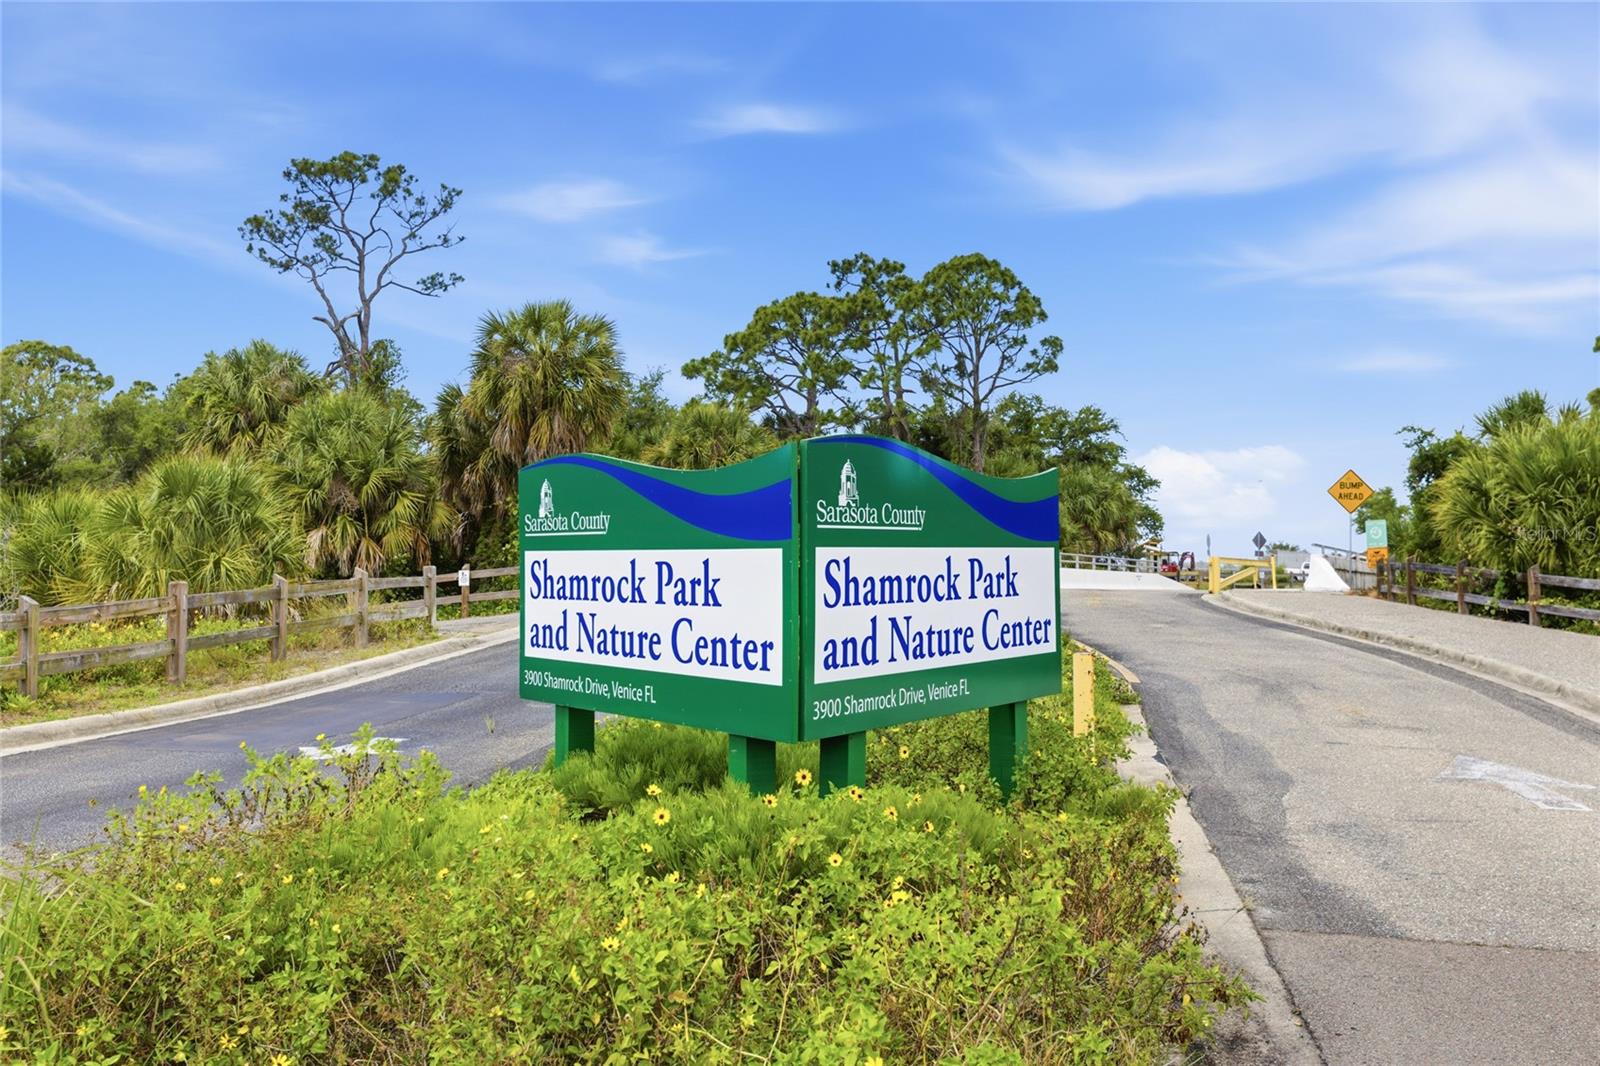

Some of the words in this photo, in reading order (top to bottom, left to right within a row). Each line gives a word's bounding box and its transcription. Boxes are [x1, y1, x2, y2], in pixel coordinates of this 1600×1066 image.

[816, 499, 879, 524] Sarasota
[881, 502, 926, 530] County
[1338, 492, 1364, 500] AHEAD
[524, 513, 568, 532] Sarasota
[571, 511, 611, 534] County
[529, 558, 647, 604] Shamrock
[655, 558, 722, 607] Park
[823, 555, 962, 609] Shamrock
[968, 555, 1019, 599] Park
[530, 609, 569, 651] and
[576, 612, 662, 660] Nature
[671, 617, 774, 672] Center
[823, 615, 879, 671] and
[888, 616, 975, 663] Nature
[981, 608, 1051, 651] Center
[524, 670, 543, 686] 3900
[544, 672, 583, 693] Shamrock
[585, 677, 610, 699] Drive,
[611, 681, 643, 702] Venice
[644, 685, 656, 704] FL
[812, 698, 842, 720] 3900
[844, 689, 897, 715] Shamrock
[899, 687, 927, 706] Drive,
[928, 681, 958, 700] Venice
[959, 678, 970, 695] FL
